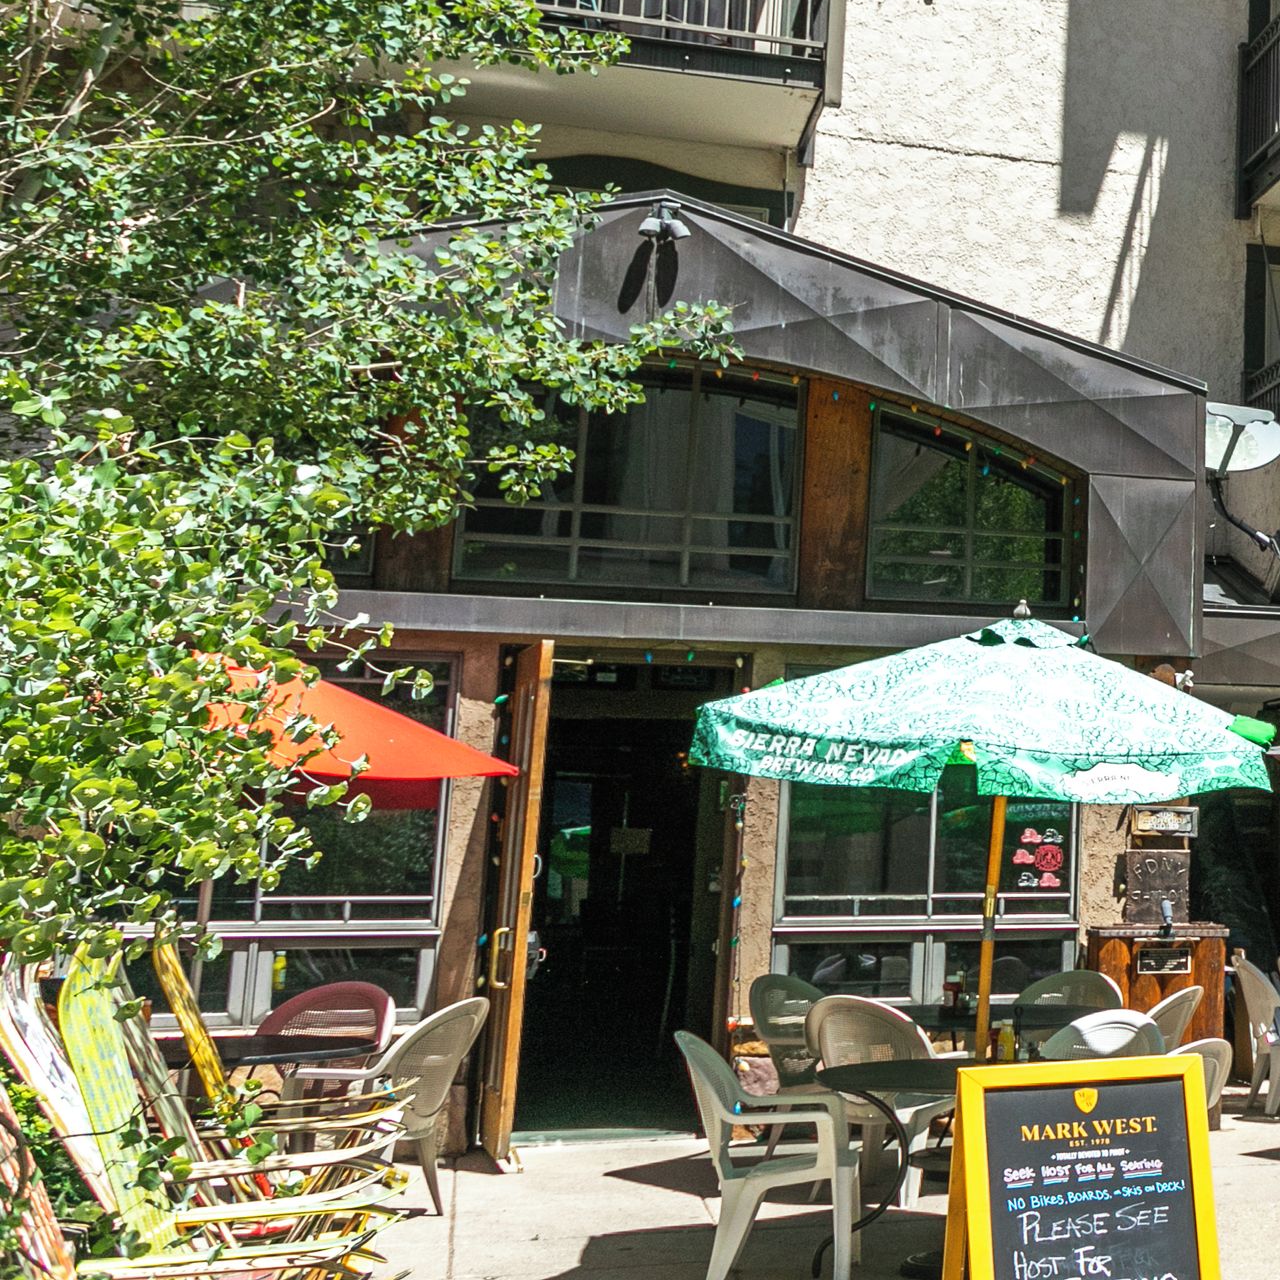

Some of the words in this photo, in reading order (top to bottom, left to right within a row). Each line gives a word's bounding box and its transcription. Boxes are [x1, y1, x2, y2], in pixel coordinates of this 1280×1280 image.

[725, 729, 817, 756] SIERRA
[758, 754, 845, 780] BREWING
[1021, 1122, 1089, 1141] MARK
[1093, 1116, 1157, 1136] WEST.
[1069, 1139, 1088, 1147] EST.
[1041, 1164, 1071, 1177] HOST
[1017, 1210, 1110, 1245] PLEASE
[1115, 1201, 1170, 1231] SEE
[1013, 1250, 1066, 1280] HOST
[1074, 1245, 1112, 1277] FOR
